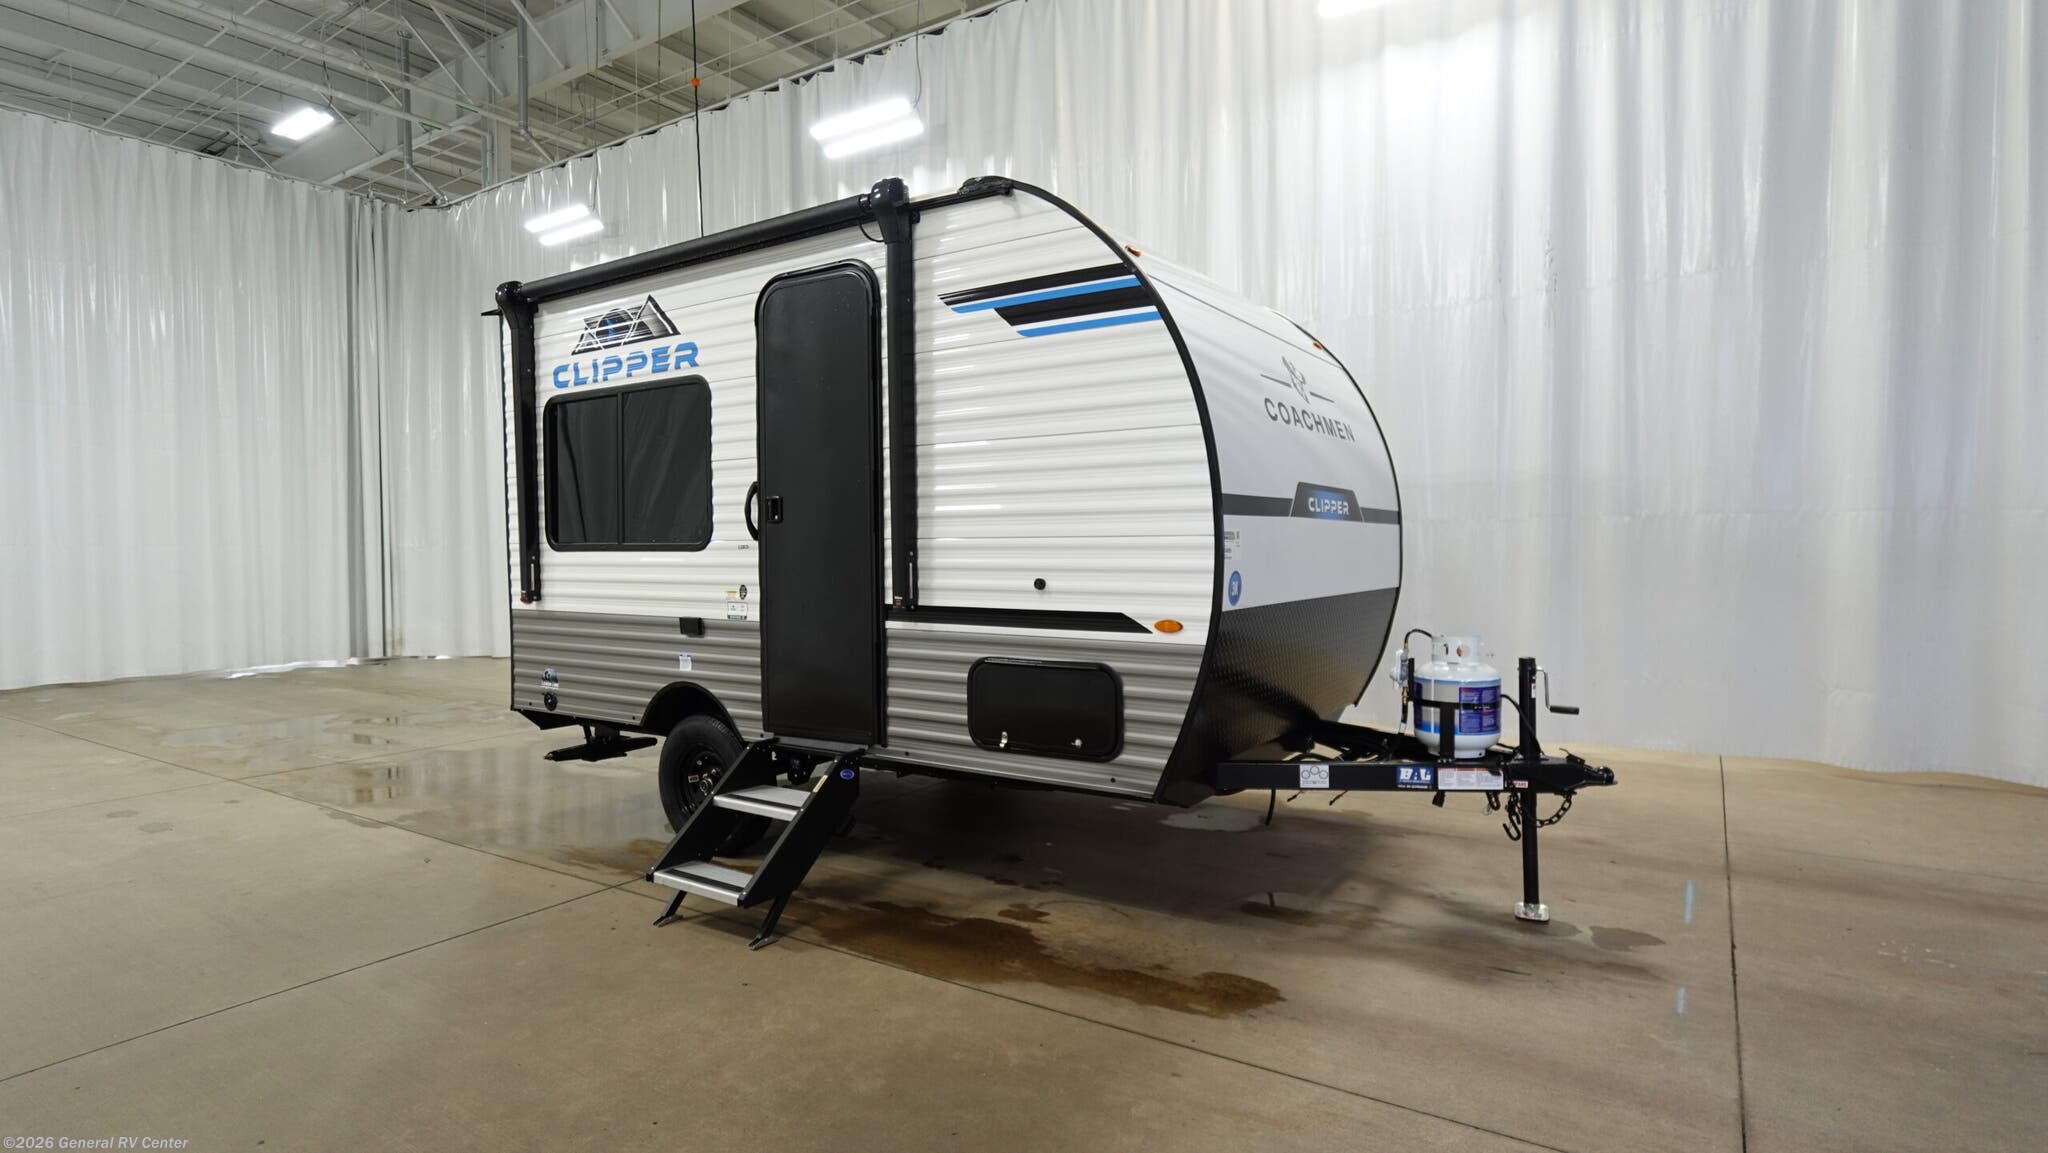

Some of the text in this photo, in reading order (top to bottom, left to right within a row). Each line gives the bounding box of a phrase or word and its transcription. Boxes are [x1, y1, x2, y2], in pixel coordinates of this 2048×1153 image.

[553, 341, 699, 389] CLIPPER
[1264, 397, 1355, 442] COACHMEN
[1308, 497, 1349, 516] CLIPPER
